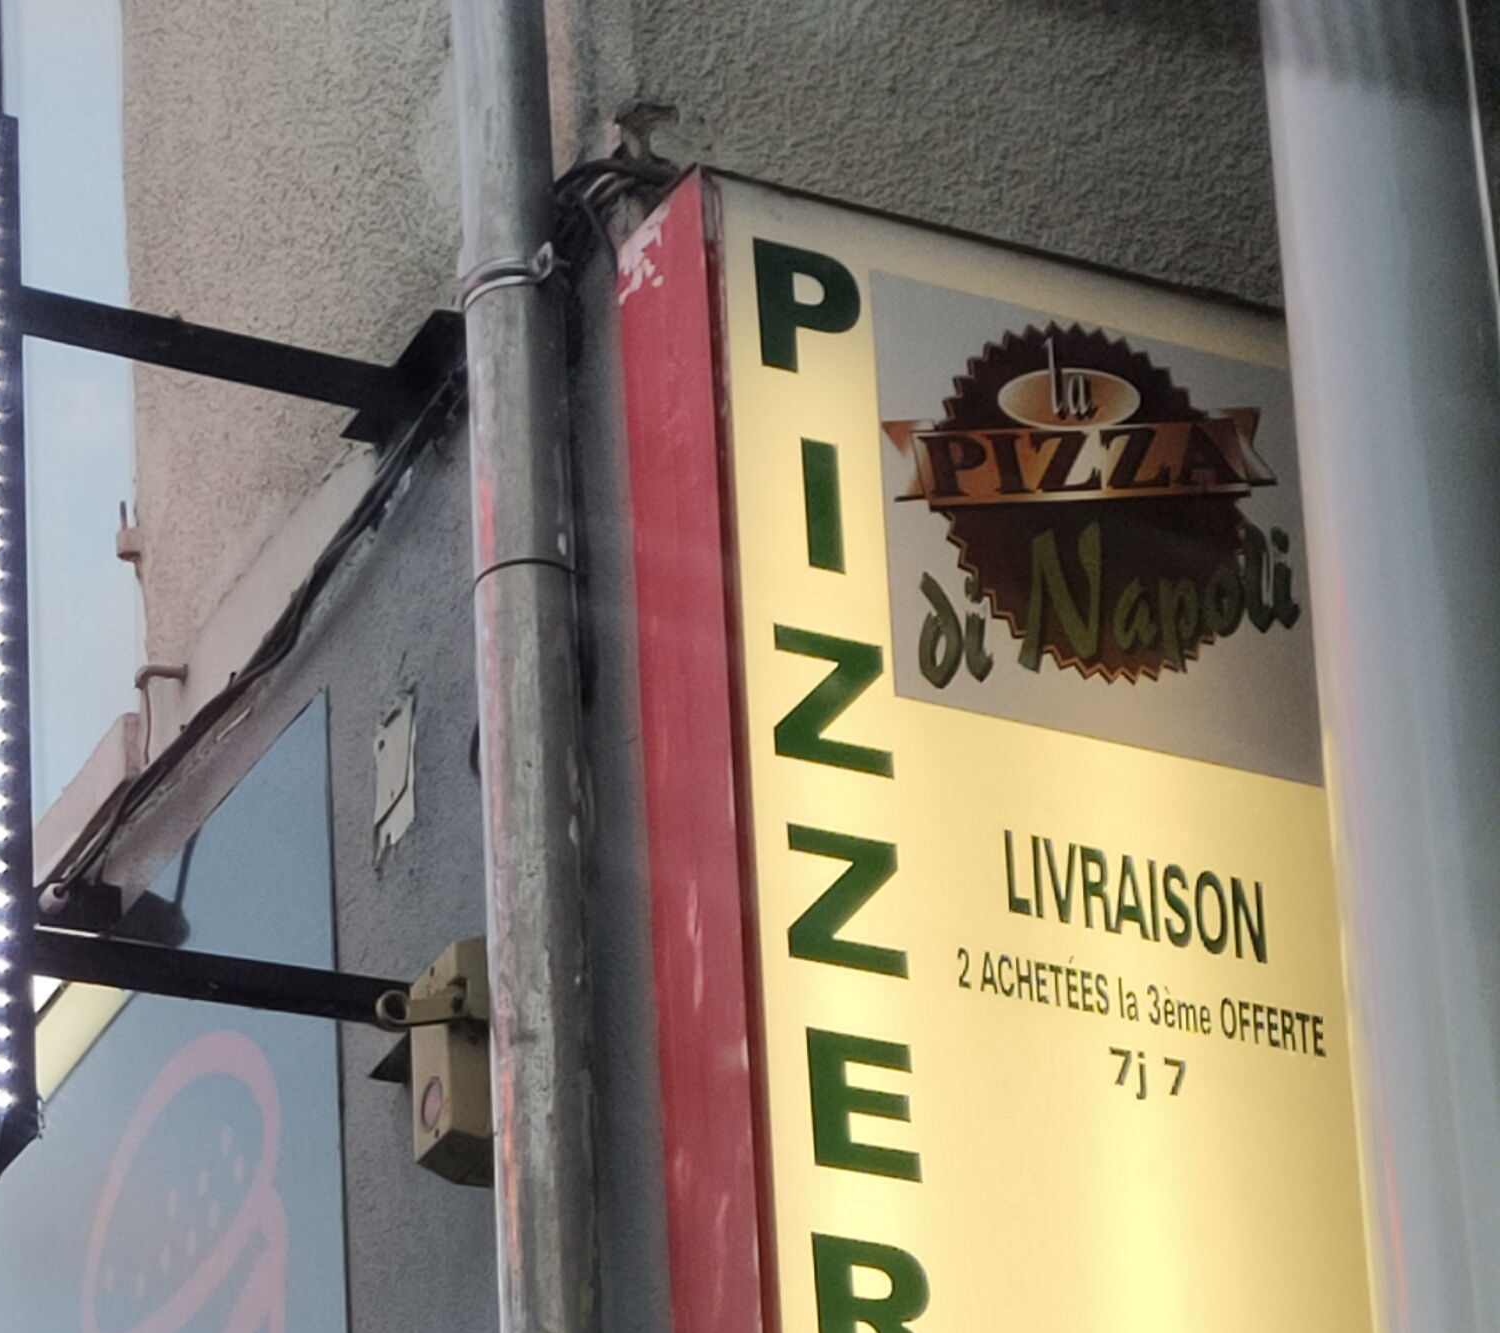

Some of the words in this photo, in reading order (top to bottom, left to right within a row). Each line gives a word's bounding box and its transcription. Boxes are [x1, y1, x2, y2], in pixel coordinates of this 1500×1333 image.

[1044, 336, 1098, 420] la
[917, 424, 1248, 498] PIZZA
[919, 571, 994, 688] di
[1017, 520, 1301, 674] Napoli
[1003, 829, 1267, 963] LIVRAISON
[957, 948, 972, 989] 2
[980, 950, 1110, 1016] ACHETÉES
[1118, 982, 1140, 1022] la
[1147, 984, 1212, 1036] 3ème
[1220, 996, 1327, 1058] OFFERTE
